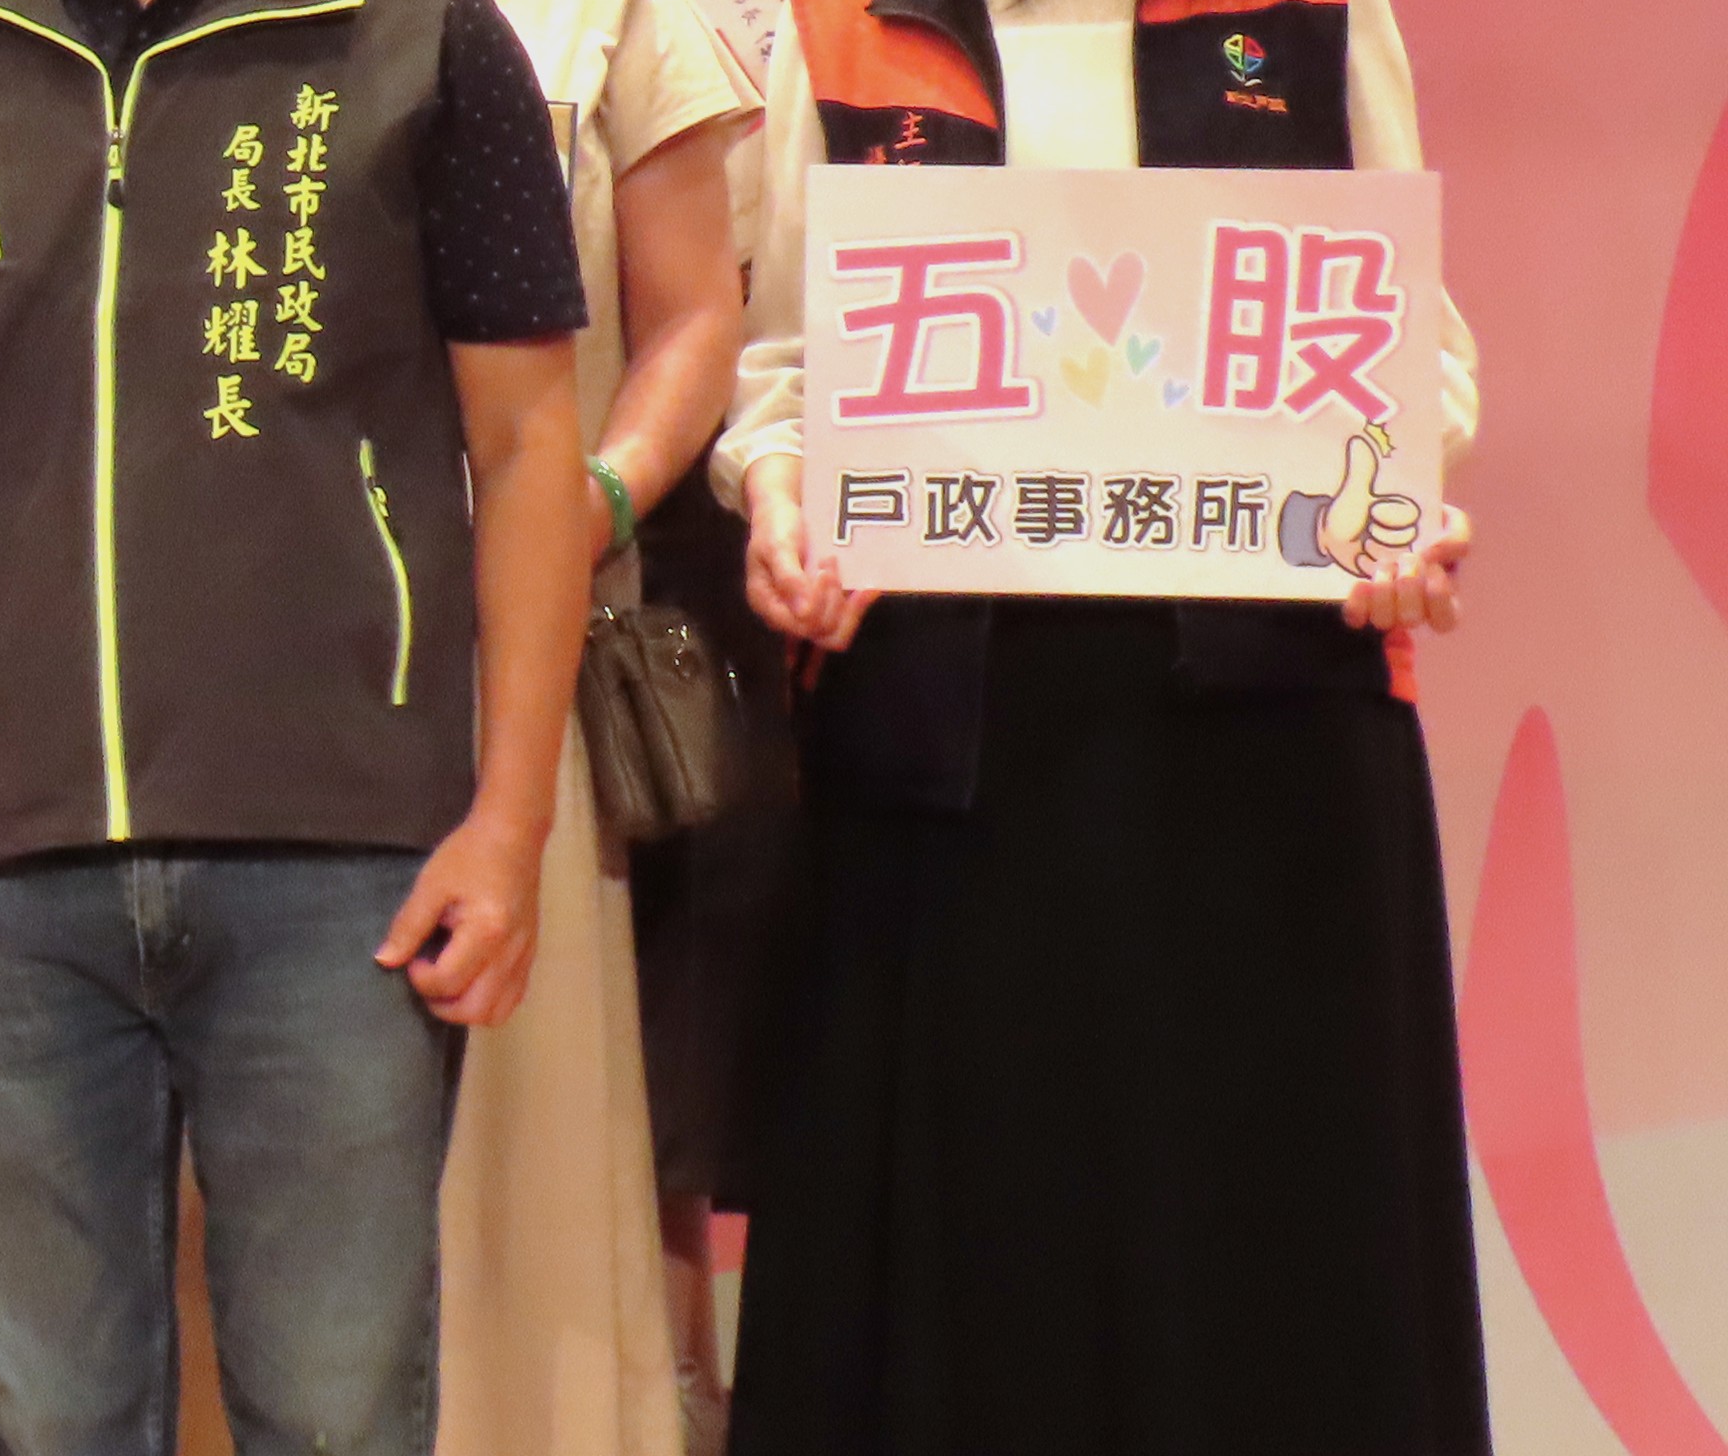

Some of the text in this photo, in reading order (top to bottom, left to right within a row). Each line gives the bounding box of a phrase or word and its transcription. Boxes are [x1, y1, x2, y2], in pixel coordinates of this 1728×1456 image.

[202, 122, 269, 440] 局長林耀長
[273, 83, 341, 384] 新北市民政局
[832, 222, 1403, 424] 五 股
[834, 472, 1268, 550] 戶政事務所
